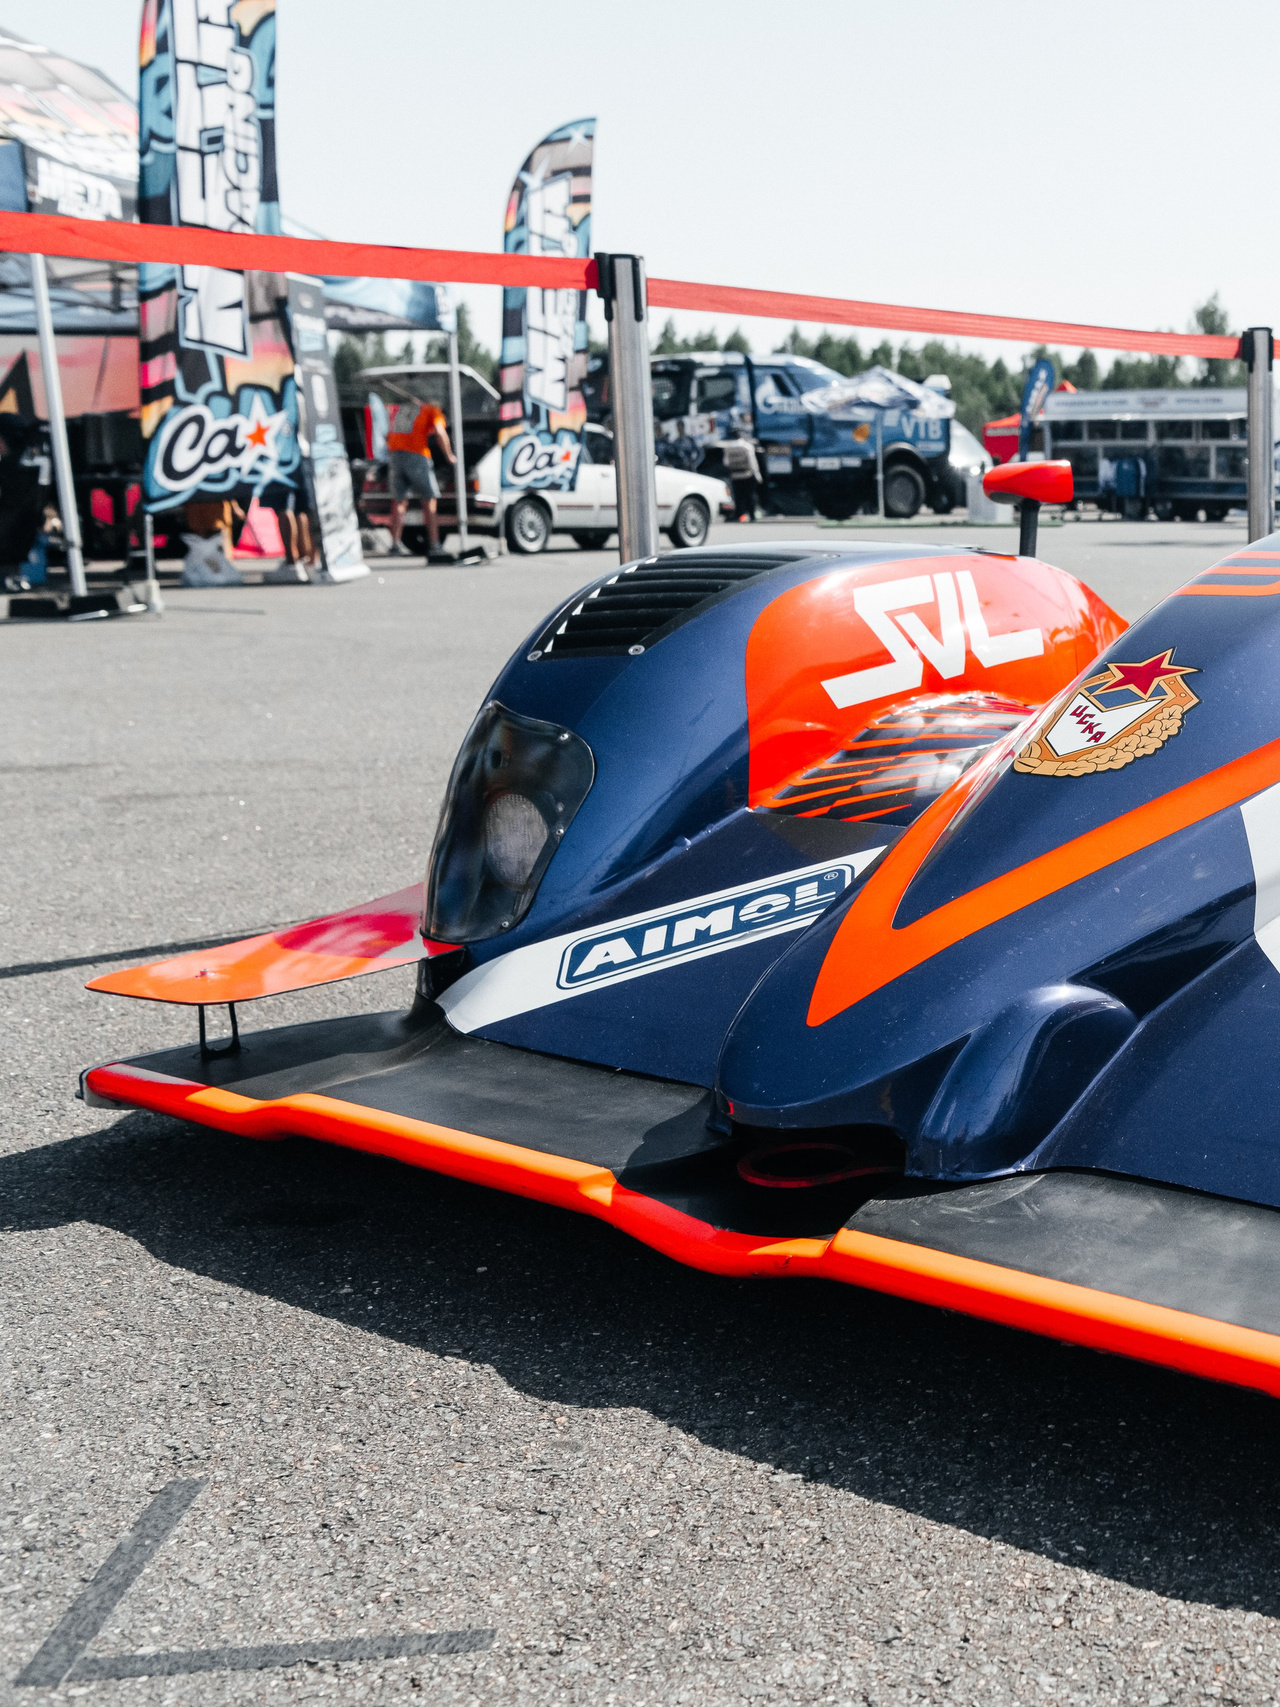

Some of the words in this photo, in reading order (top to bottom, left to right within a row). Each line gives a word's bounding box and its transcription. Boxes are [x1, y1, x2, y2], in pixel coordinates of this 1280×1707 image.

[902, 416, 943, 440] VTB
[820, 570, 1044, 709] SVL
[1069, 704, 1107, 743] ЦСКА
